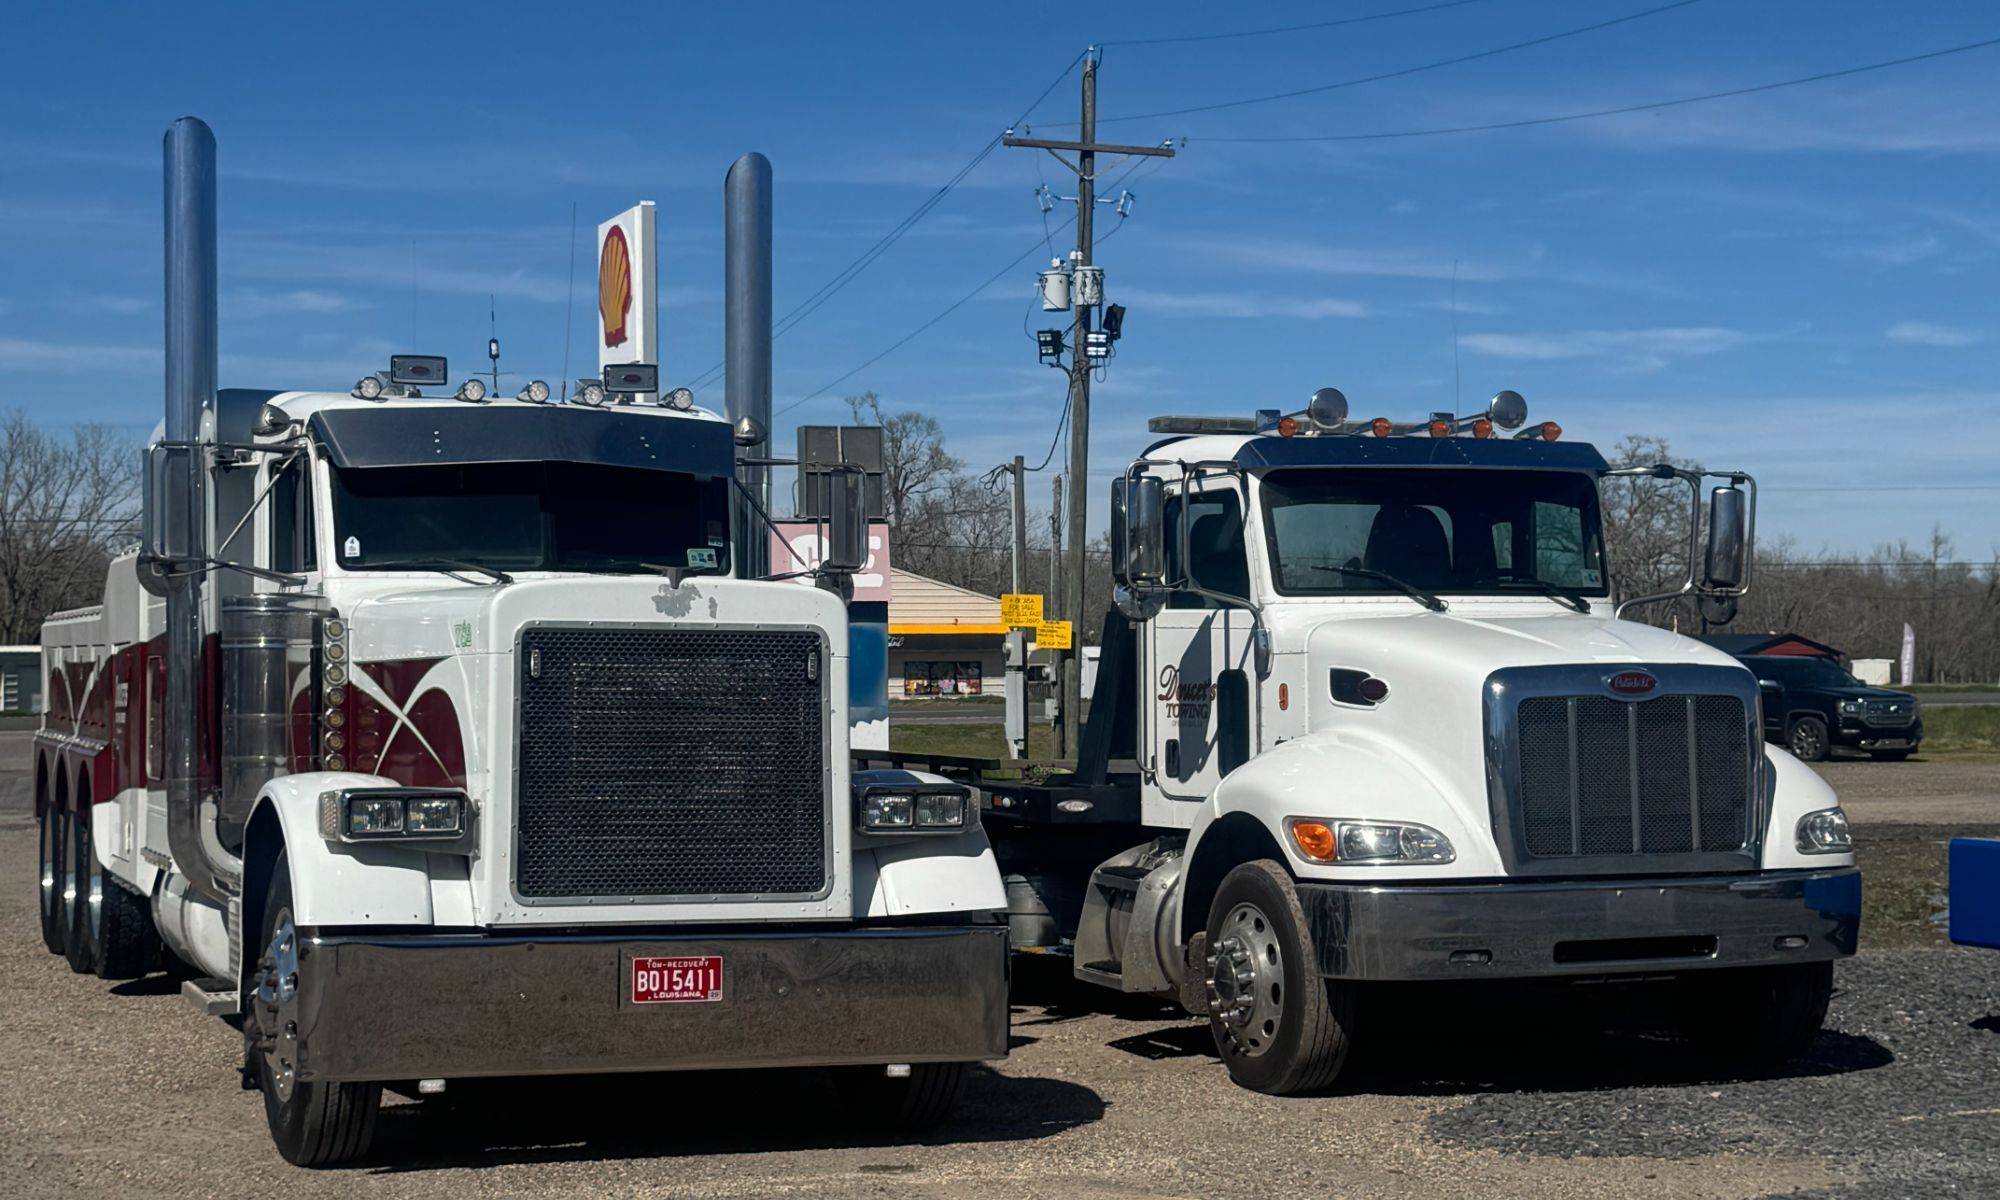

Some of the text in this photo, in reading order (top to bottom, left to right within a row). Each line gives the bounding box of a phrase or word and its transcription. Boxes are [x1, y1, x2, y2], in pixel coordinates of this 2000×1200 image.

[1166, 702, 1209, 719] TOWING
[637, 969, 714, 992] B015411
[653, 991, 701, 999] LOUISIANA
